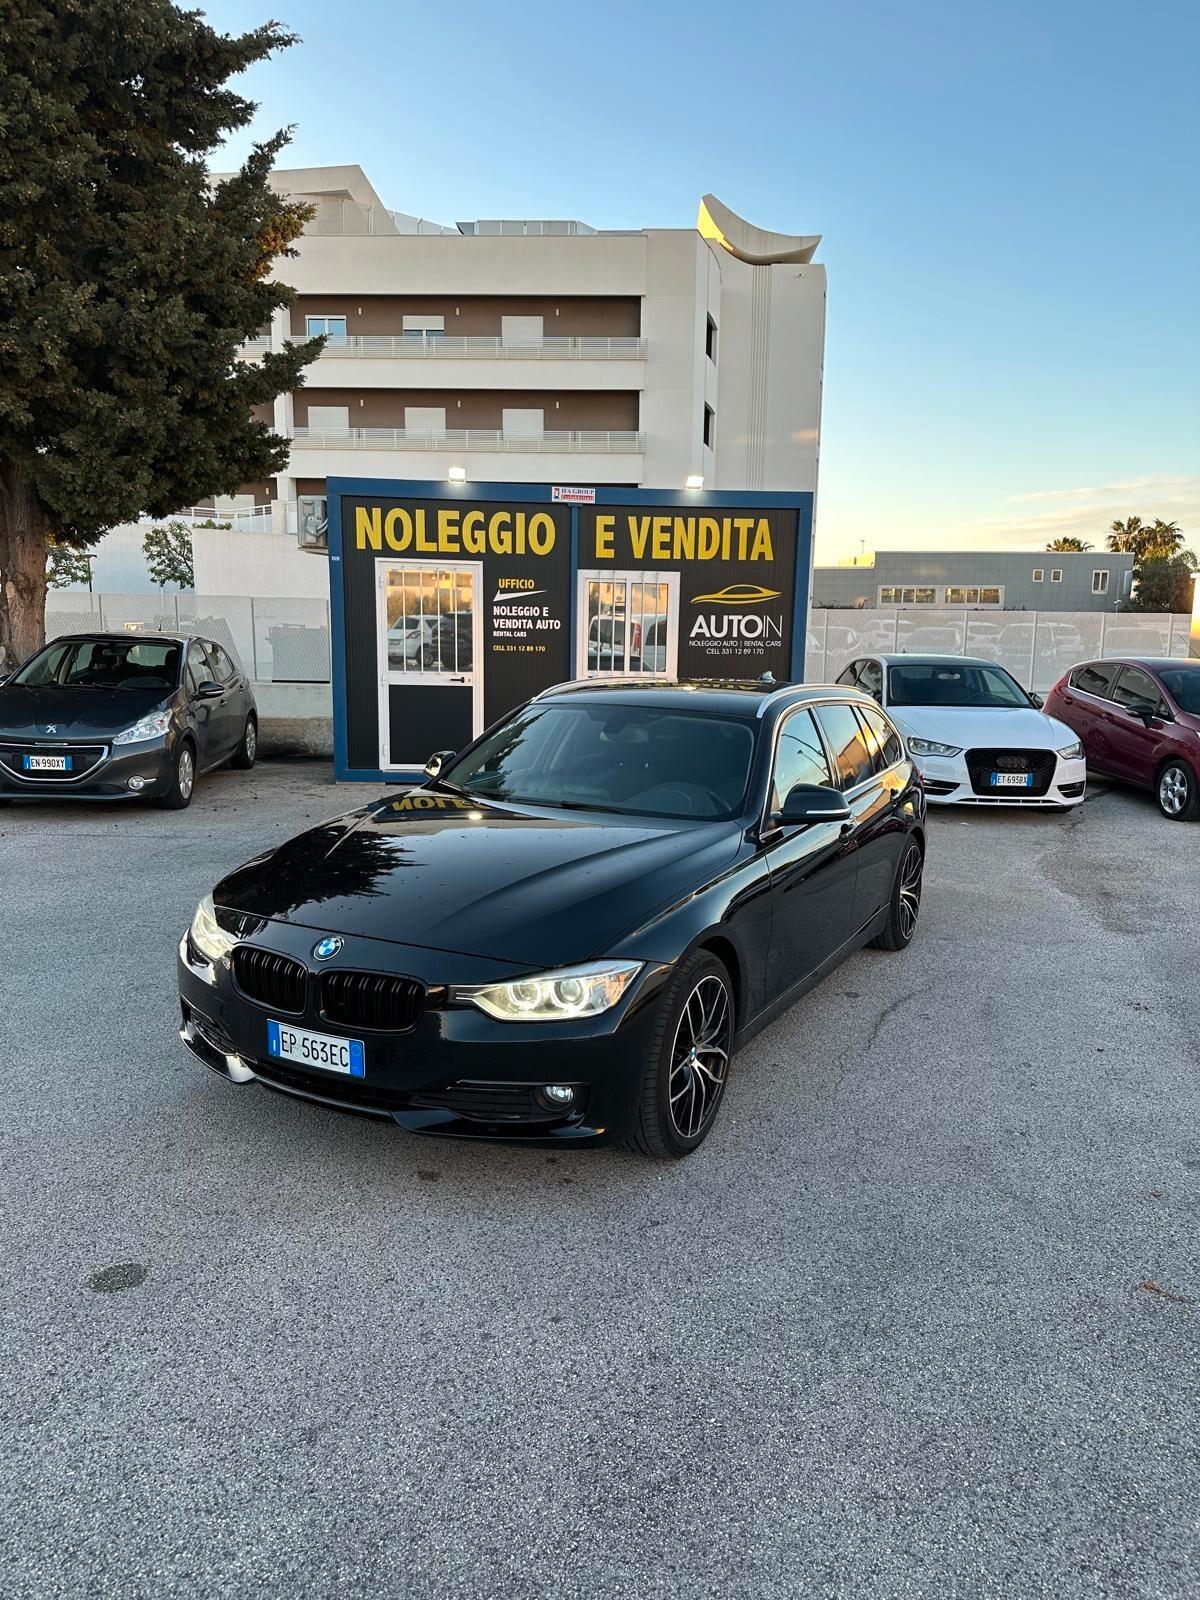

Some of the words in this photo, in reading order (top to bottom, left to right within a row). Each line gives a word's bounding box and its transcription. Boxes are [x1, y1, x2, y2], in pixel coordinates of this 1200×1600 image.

[355, 506, 556, 556] NOLEGGIO
[595, 515, 616, 558] E
[627, 515, 774, 561] VENDITA
[498, 578, 535, 589] UFFICIO
[493, 605, 540, 616] NOLEGGIO
[542, 606, 549, 617] E
[493, 618, 534, 629] VENDITA
[535, 620, 561, 630] AUTO
[689, 614, 783, 638] AUTOIN
[493, 630, 513, 638] RENTAL
[493, 644, 505, 652] CELL
[526, 645, 534, 653] 89
[535, 645, 546, 653] 170
[688, 640, 722, 648] NOLEGGIO
[743, 640, 764, 648] RENTAL
[765, 640, 782, 648] CARS
[31, 758, 40, 768] EN
[42, 758, 65, 768] 990XY
[997, 775, 1006, 784] ET
[281, 1030, 297, 1054] EP
[301, 1037, 349, 1068] 563EC
